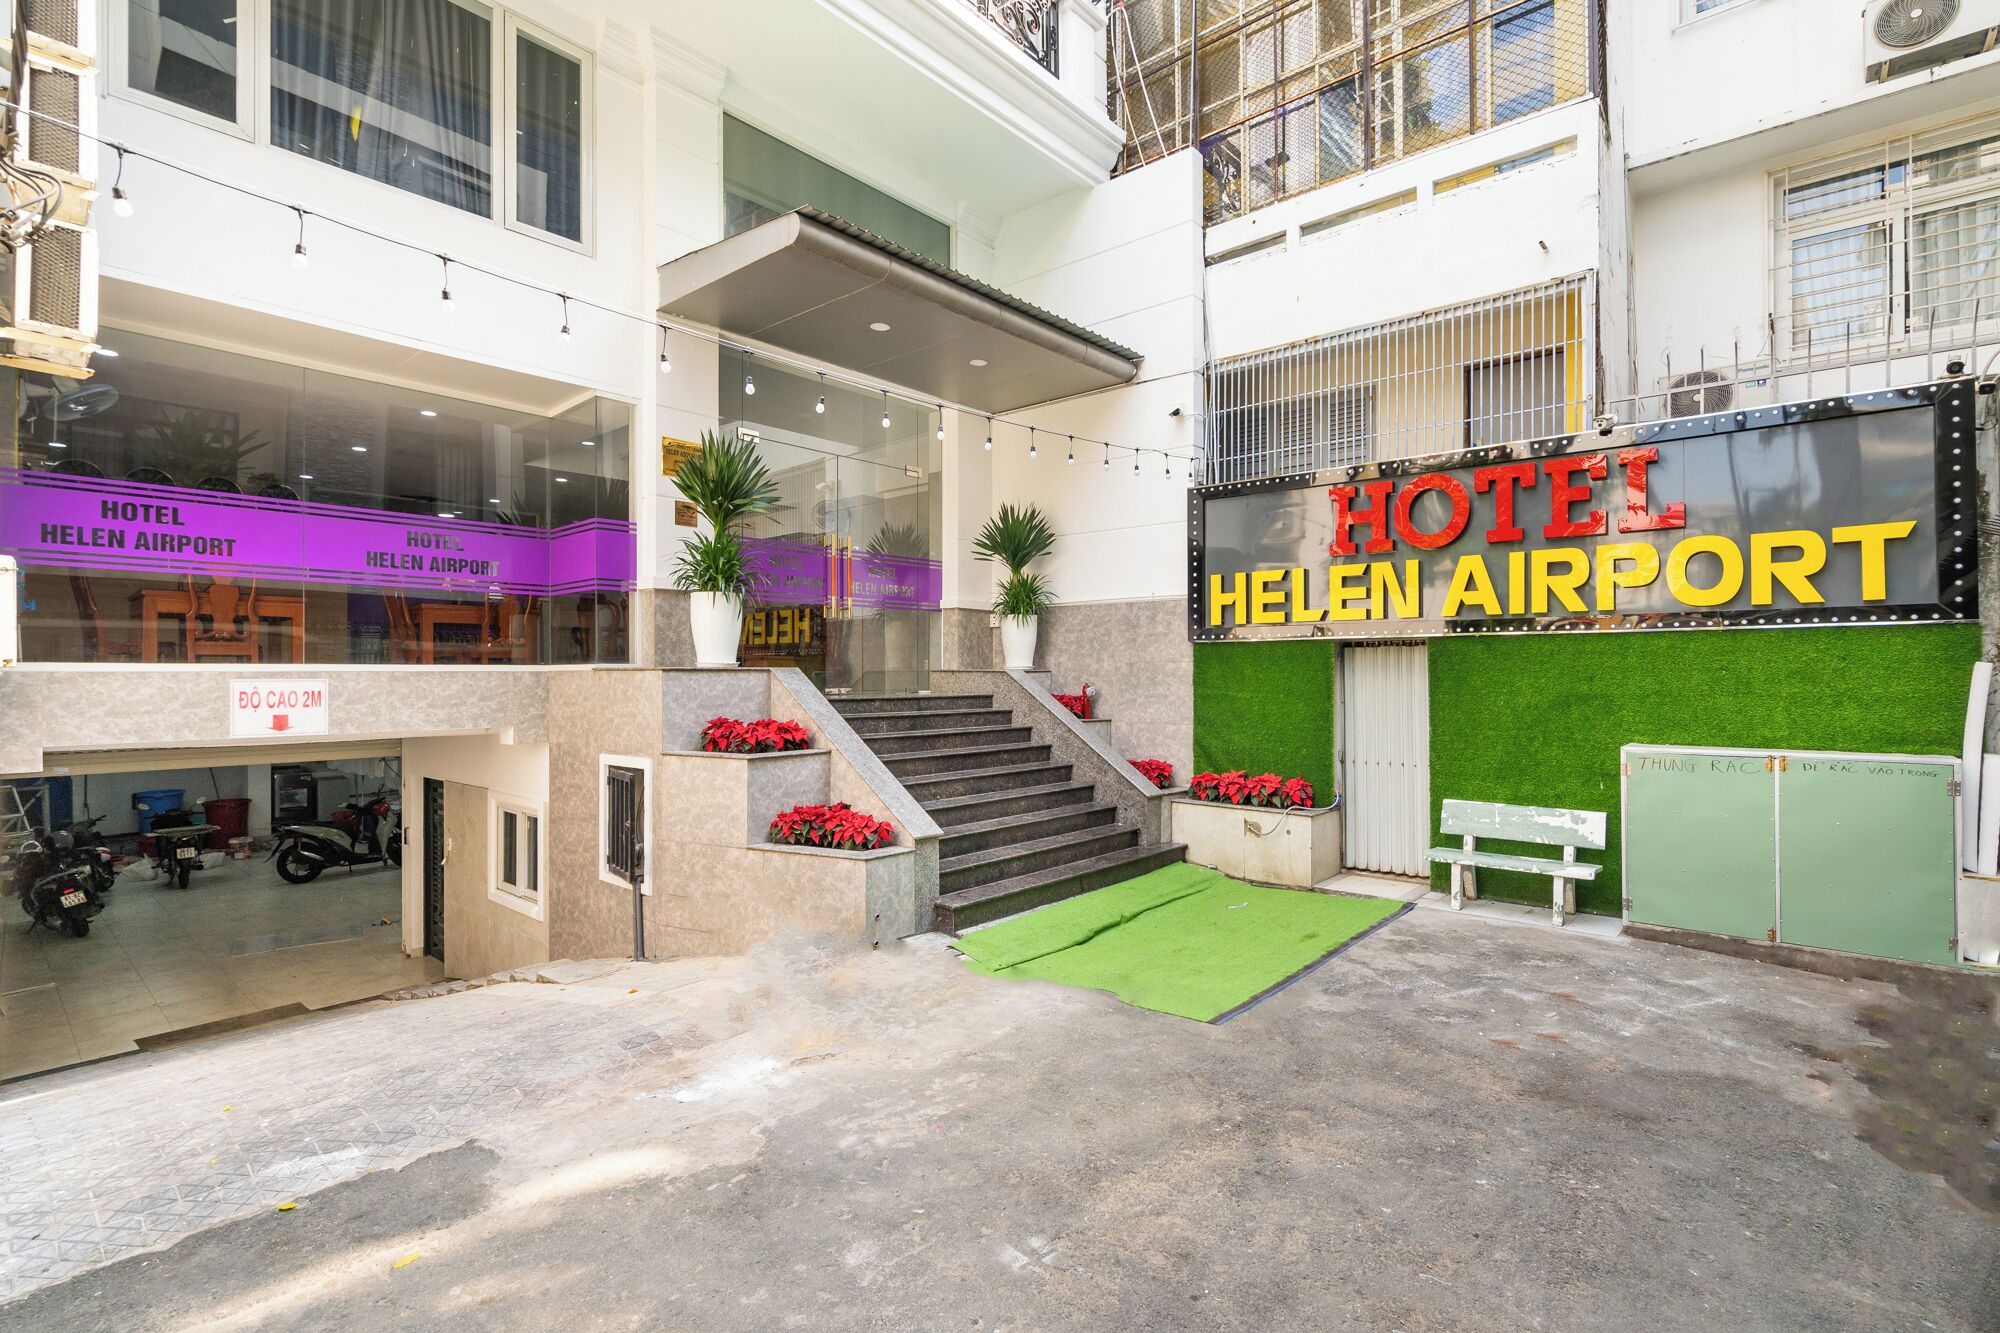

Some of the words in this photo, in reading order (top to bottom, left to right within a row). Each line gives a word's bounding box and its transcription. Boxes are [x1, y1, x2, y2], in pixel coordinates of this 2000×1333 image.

[101, 500, 185, 526] HOTEL
[1328, 447, 1687, 557] HOTEL
[41, 523, 125, 549] HELEN
[134, 531, 236, 557] AIRPORT
[406, 530, 464, 551] HOTEL
[366, 551, 423, 571] HELEN
[429, 556, 499, 577] AIRPORT
[868, 565, 897, 580] HOTEL
[1209, 559, 1420, 627] HELEN
[1440, 520, 1918, 618] AIRPORT
[239, 686, 261, 712] ĐỘ
[266, 690, 298, 708] CAO
[302, 690, 322, 707] 2M
